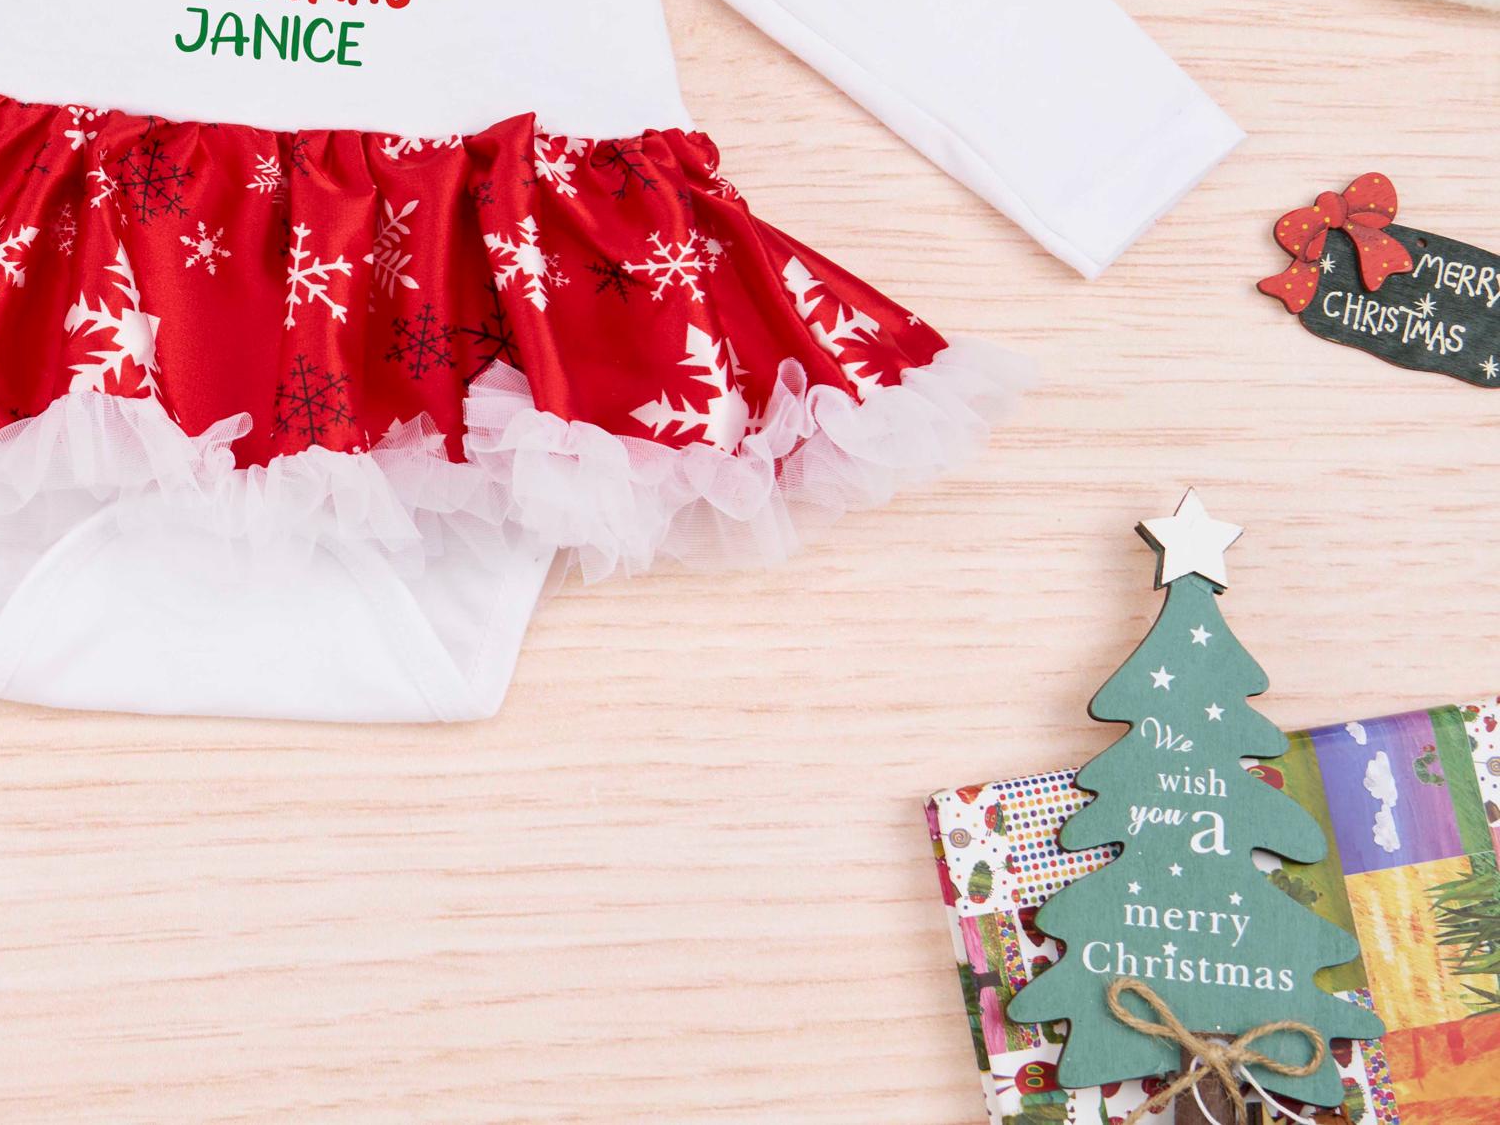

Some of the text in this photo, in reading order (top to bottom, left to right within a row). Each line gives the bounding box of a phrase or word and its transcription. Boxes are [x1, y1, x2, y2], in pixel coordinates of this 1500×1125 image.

[174, 7, 365, 67] JANICE
[1323, 291, 1467, 355] CHRISTMAS
[1141, 717, 1194, 752] We
[1157, 767, 1228, 797] wish
[1128, 804, 1230, 856] you a
[1124, 903, 1250, 947] merry
[1082, 941, 1294, 992] Christmas
